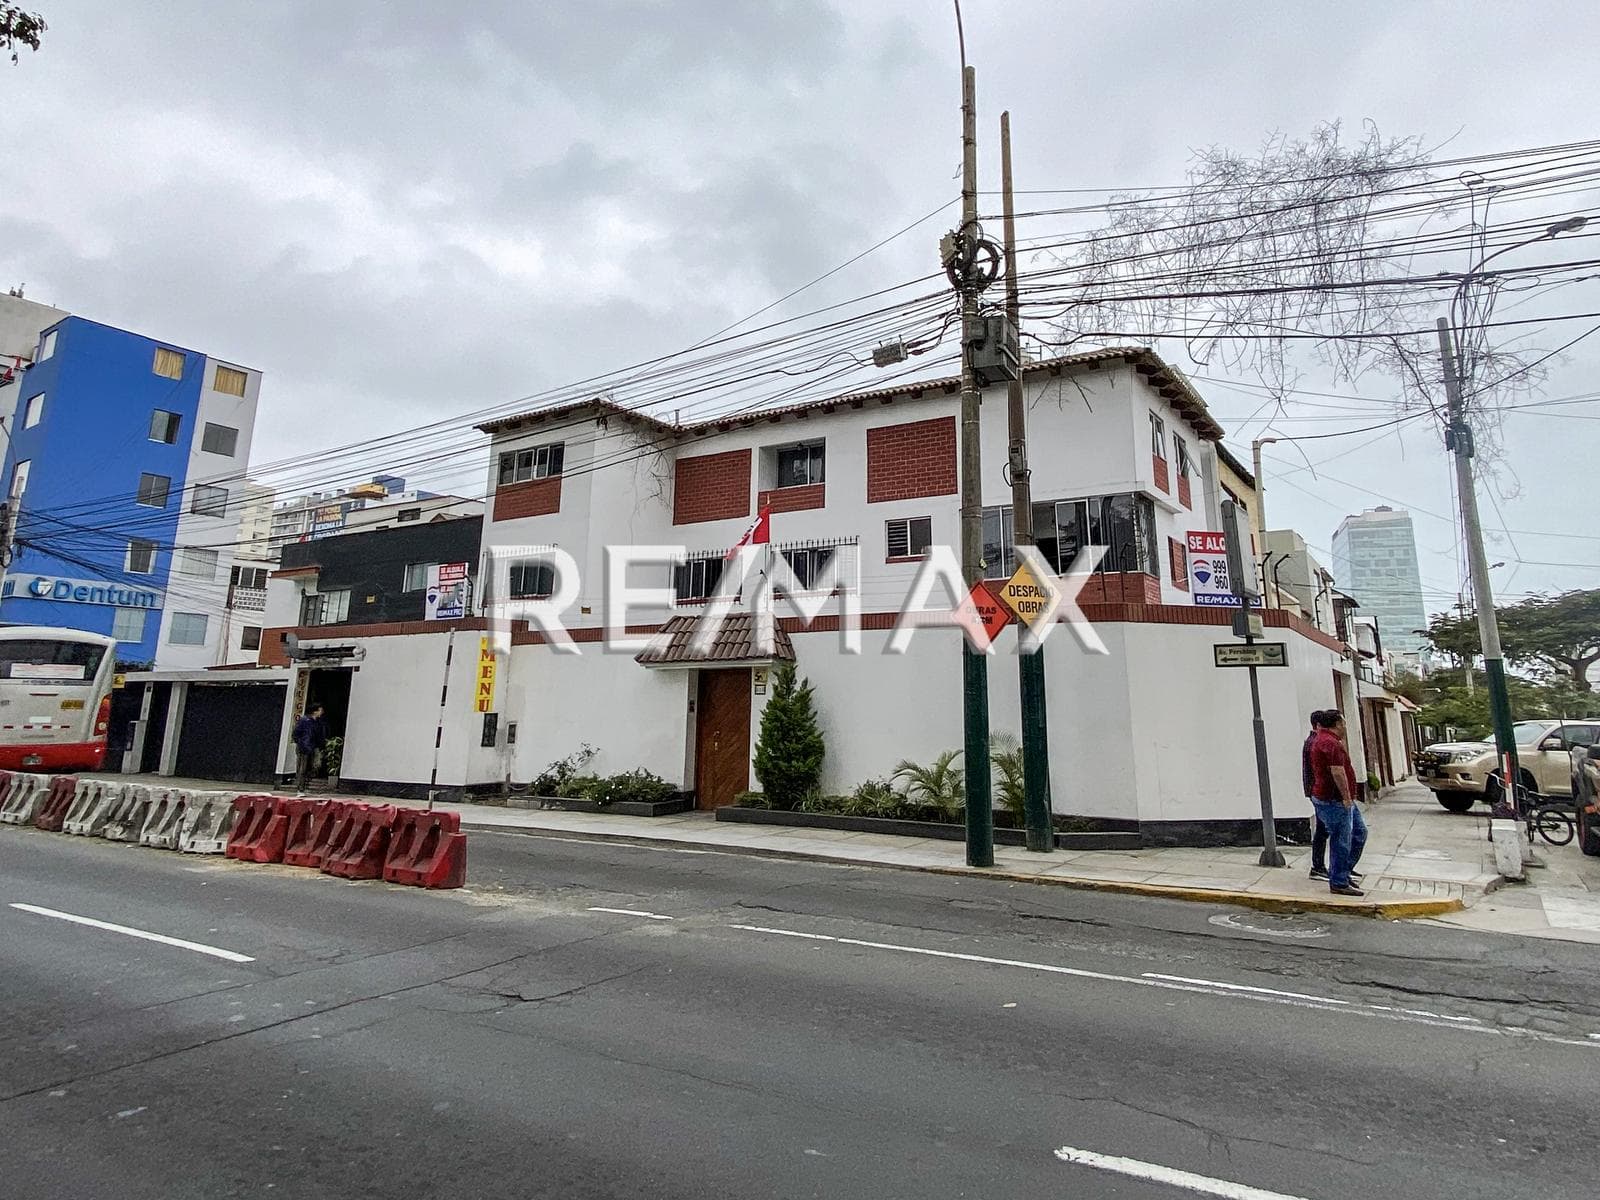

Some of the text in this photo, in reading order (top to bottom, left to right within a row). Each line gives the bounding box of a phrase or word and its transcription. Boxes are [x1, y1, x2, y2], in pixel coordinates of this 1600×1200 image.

[1189, 536, 1204, 550] SE
[1212, 560, 1226, 574] 999
[1214, 575, 1228, 589] 960
[53, 580, 156, 607] Dentum
[1009, 585, 1055, 598] DESPACIO
[1018, 601, 1050, 613] OBRAS
[1196, 595, 1238, 605] RE/MAX
